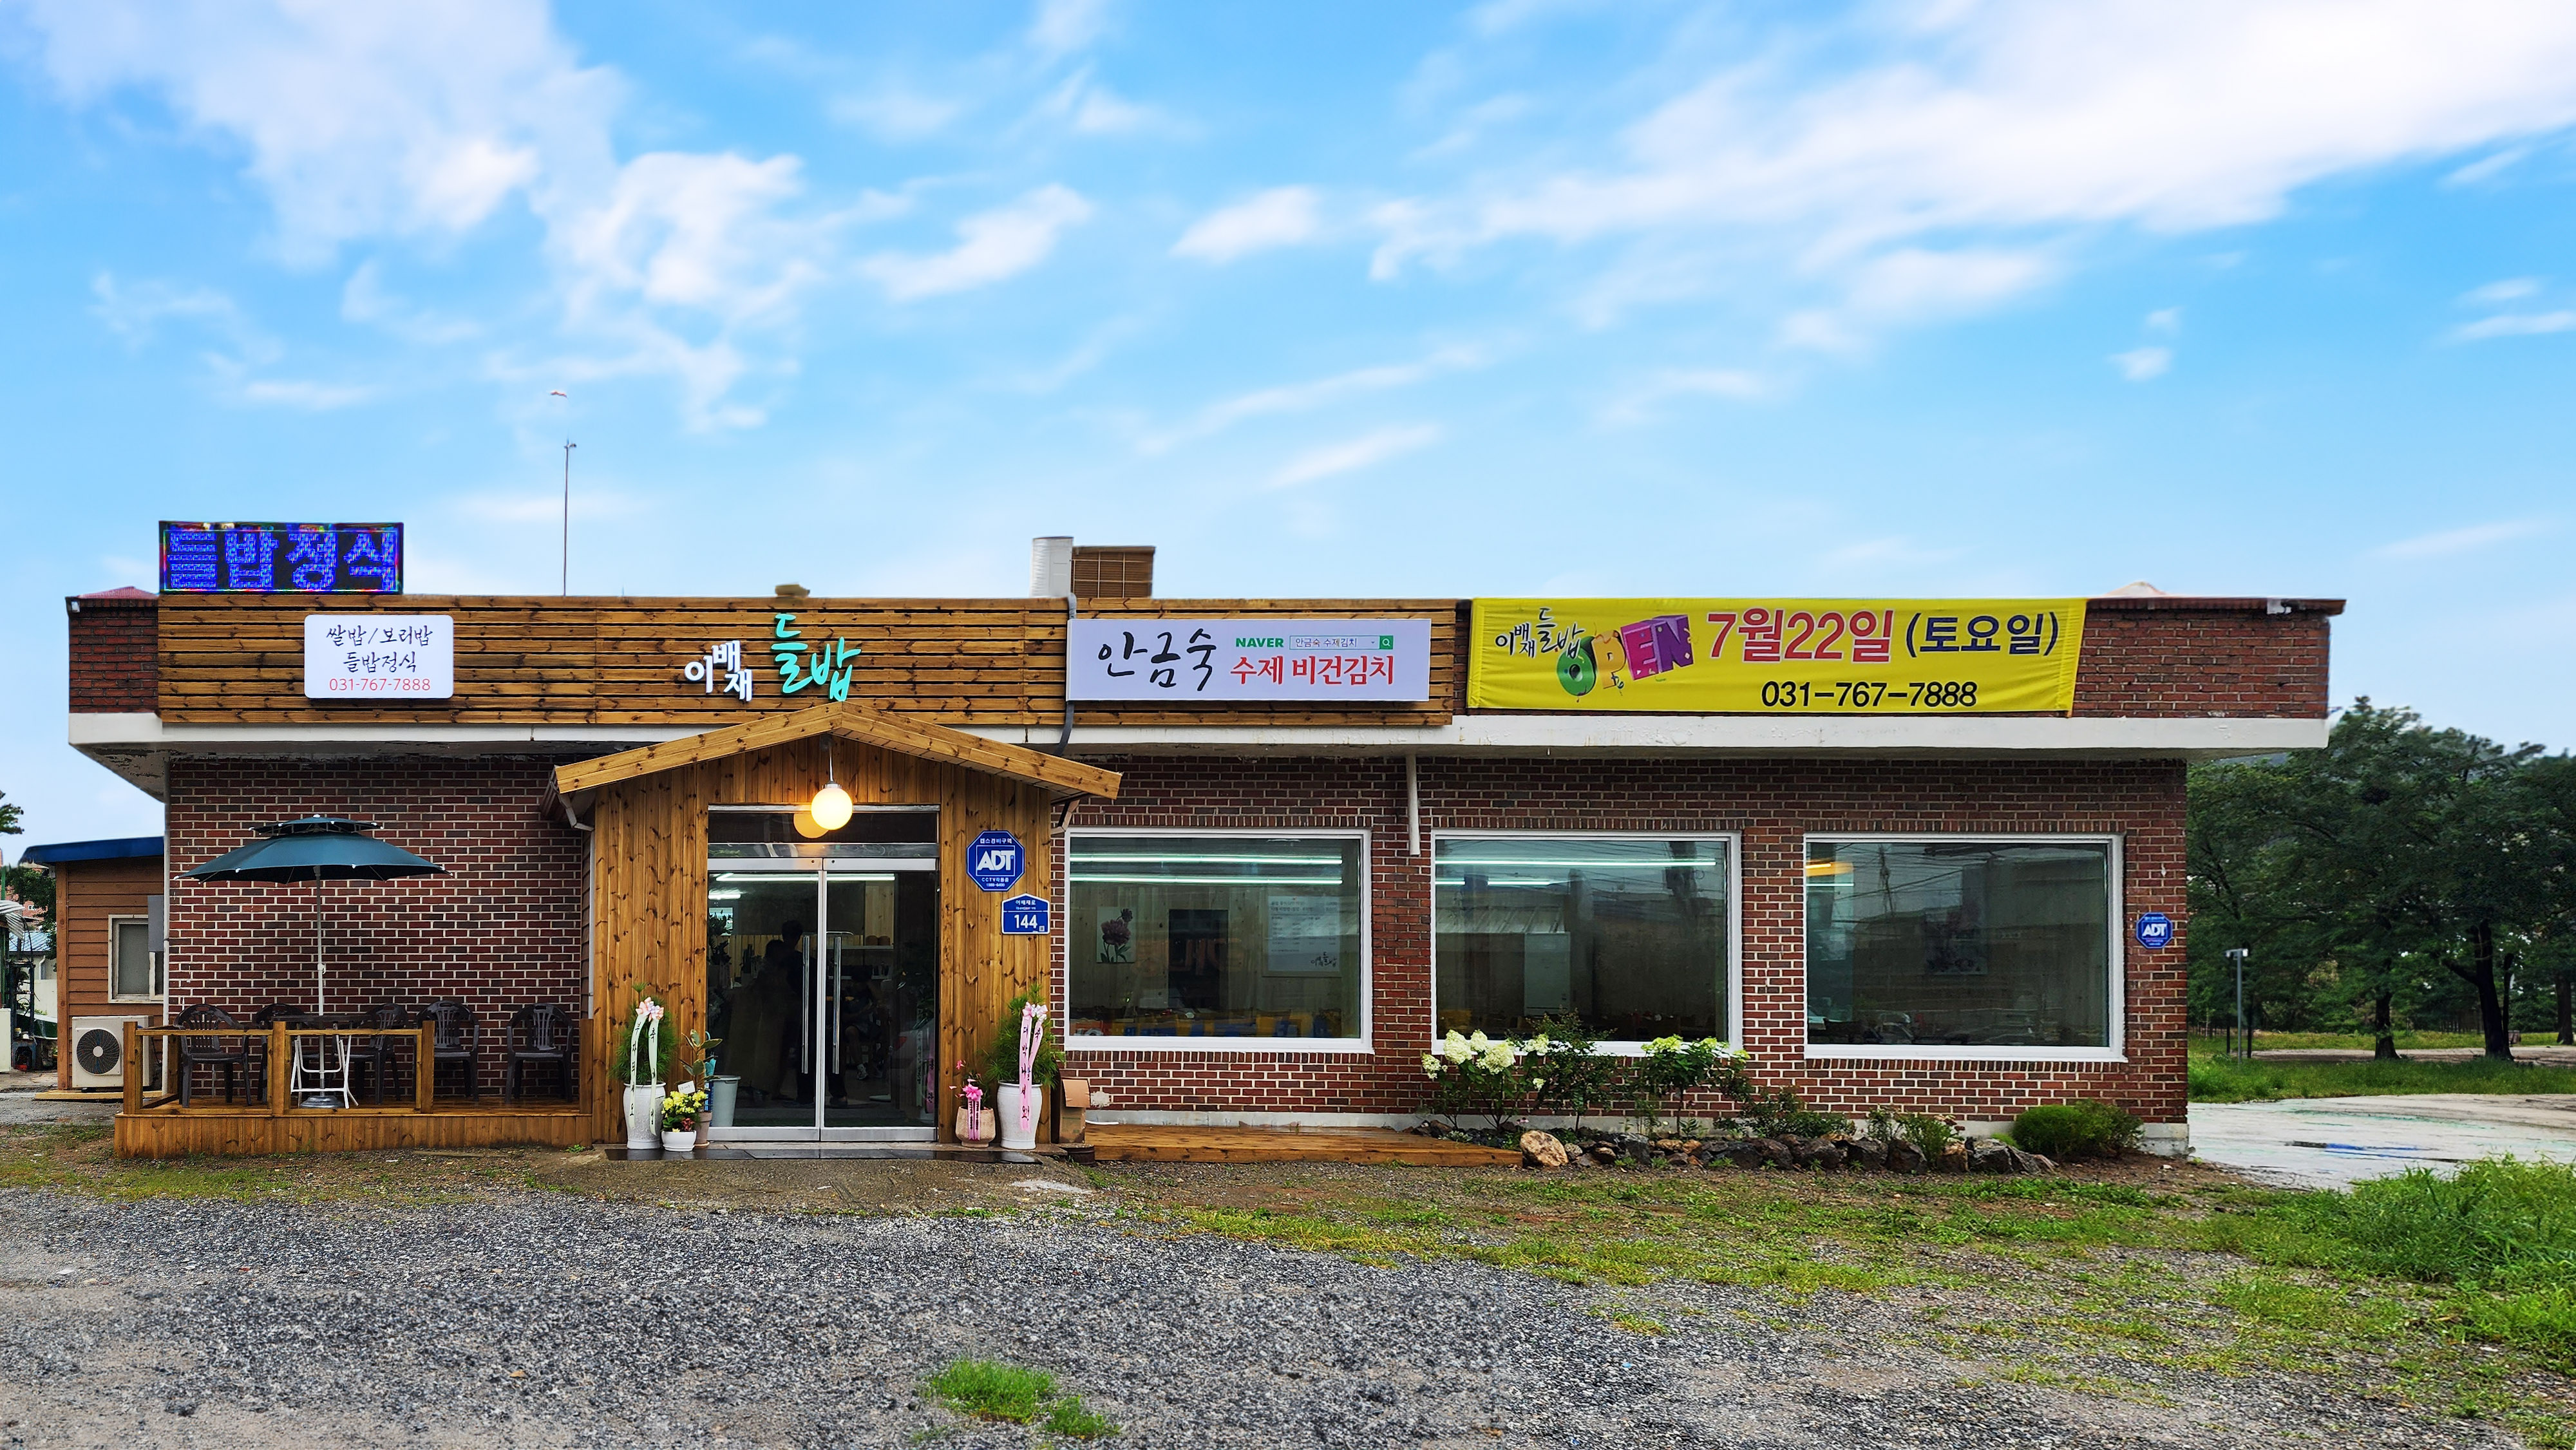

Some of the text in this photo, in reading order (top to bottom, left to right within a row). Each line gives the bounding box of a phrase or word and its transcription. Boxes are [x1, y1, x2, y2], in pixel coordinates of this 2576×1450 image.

[166, 532, 395, 592] 들밥정식
[1235, 637, 1284, 648] NAVER
[1295, 637, 1358, 648] 안금숙 수제김치
[1495, 607, 1586, 658] 이배재 들밥
[1707, 608, 2060, 663] 7월22일 (토요일)
[343, 651, 416, 673] 들밥정식
[770, 613, 862, 702] 들밥
[1097, 628, 1217, 692] 안금숙
[1556, 614, 1694, 697] OPEN
[1230, 655, 1394, 686] 수제 비건김치
[329, 678, 431, 691] 031-767-7888
[1761, 681, 1978, 708] 031-767-7888
[977, 850, 1015, 871] ADT
[1014, 914, 1038, 928] 144
[2141, 923, 2168, 937] ADT
